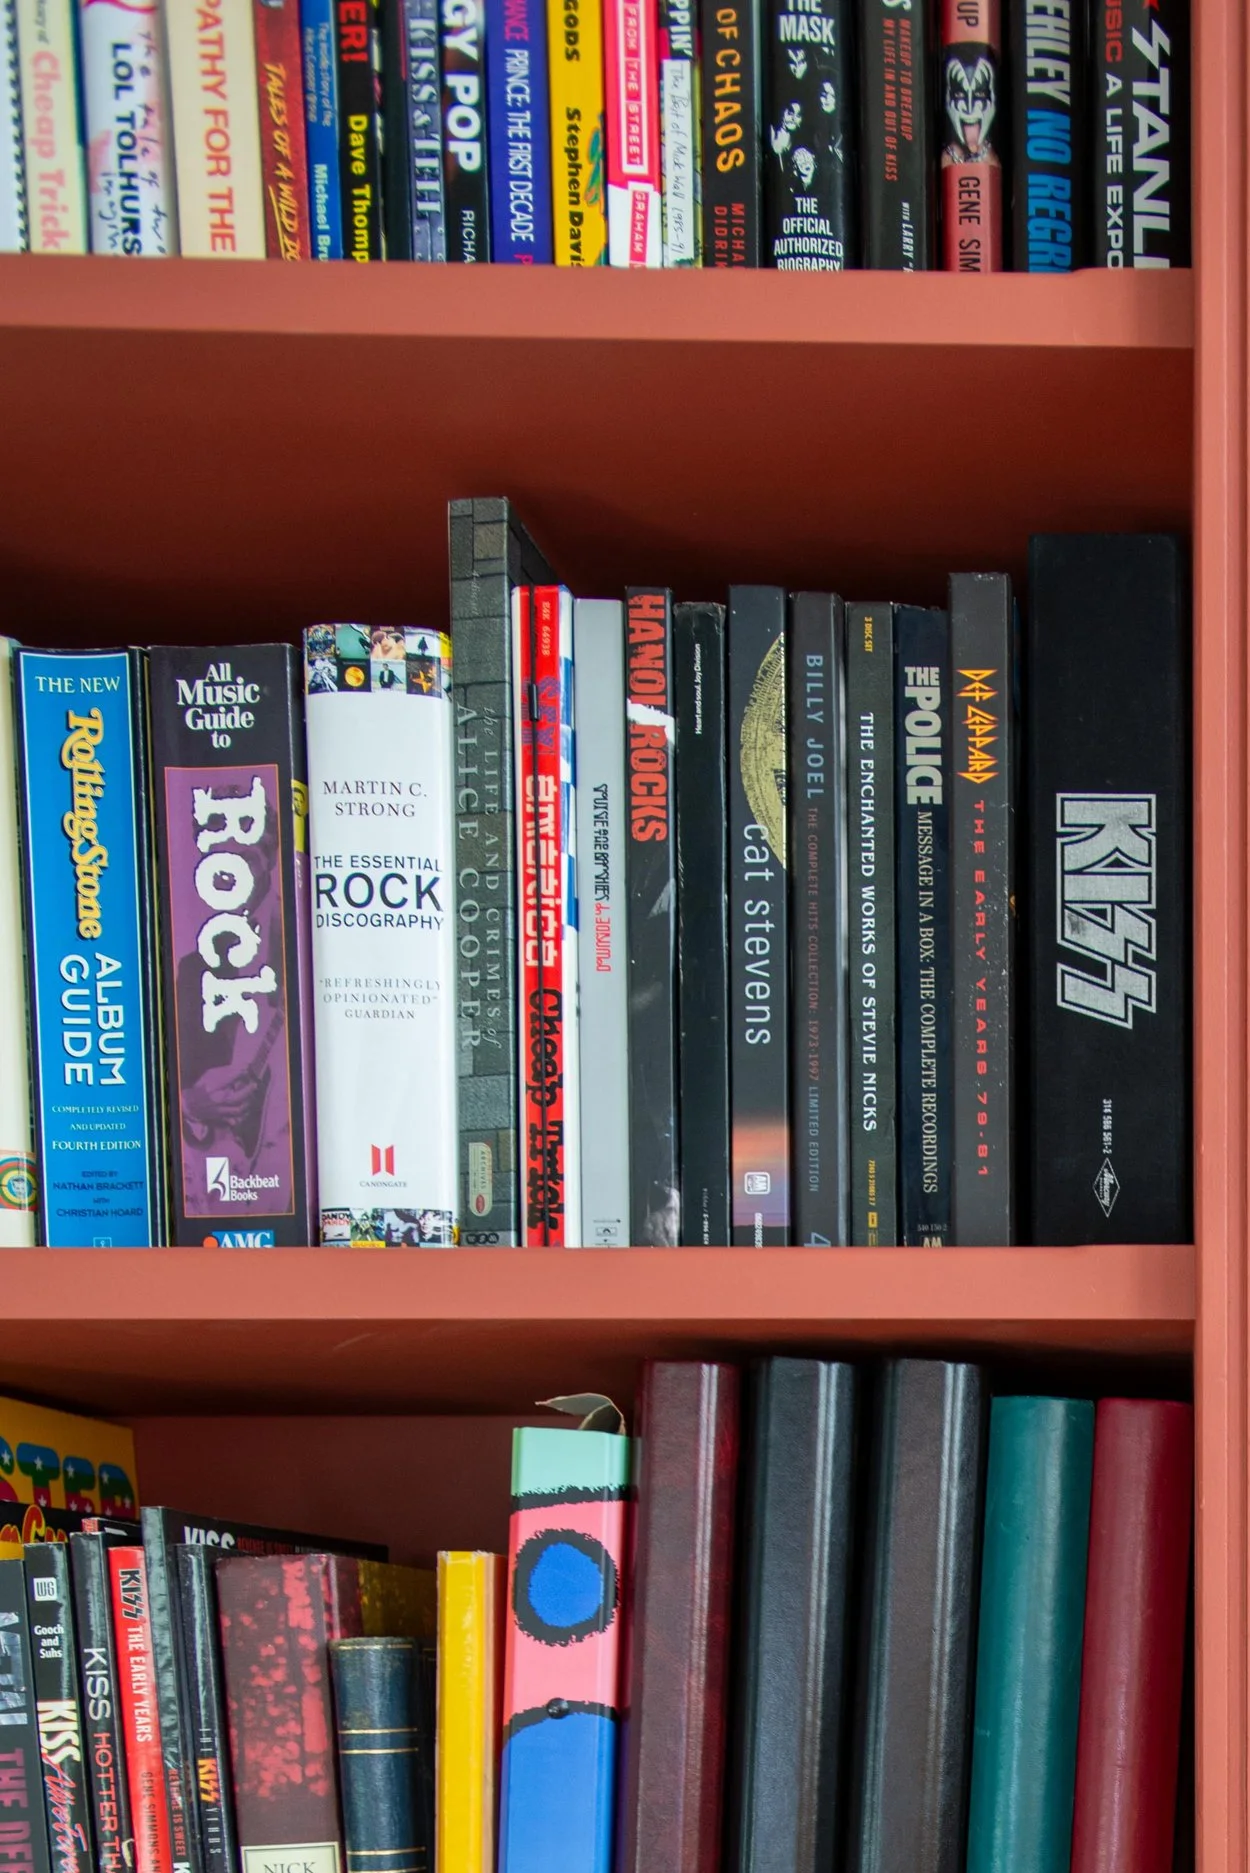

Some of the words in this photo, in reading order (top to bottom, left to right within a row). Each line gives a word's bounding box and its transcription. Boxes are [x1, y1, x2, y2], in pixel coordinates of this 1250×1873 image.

[625, 2, 638, 50] FROM
[716, 8, 738, 40] OF
[779, 14, 835, 44] MASK
[505, 49, 530, 107] PRINCE:
[627, 61, 640, 91] THE
[445, 73, 481, 172] POP
[507, 111, 531, 140] THE
[714, 51, 746, 173] CHAOS
[204, 109, 231, 177] FOR
[628, 103, 641, 165] STREET
[1027, 107, 1072, 165] NO
[508, 141, 532, 178] FIRST
[565, 107, 583, 205] Stephen
[314, 164, 330, 230] Michael
[509, 179, 535, 243] DECADE
[795, 197, 818, 214] THE
[209, 187, 236, 253] THE
[782, 217, 833, 236] OFFICIAL
[774, 237, 844, 257] AUTHORIZED
[35, 676, 76, 693] THE
[80, 676, 120, 693] NEW
[176, 676, 261, 706] Music
[205, 663, 232, 683] All
[806, 654, 824, 724] BILLY
[904, 666, 940, 686] THE
[185, 707, 255, 730] Guide
[211, 731, 232, 749] to
[860, 712, 874, 751] THE
[905, 686, 943, 805] POLICE
[456, 702, 480, 841] ALICE
[806, 737, 825, 800] JOEL
[335, 802, 416, 818] STRONG
[860, 758, 876, 878] ENCHANTED
[314, 856, 344, 869] THE
[351, 855, 444, 873] ESSENTIAL
[743, 822, 774, 882] cat
[315, 872, 444, 912] ROCK
[316, 912, 445, 931] DISCOGRAPHY
[861, 885, 876, 956] WORKS
[459, 867, 482, 1048] COOPER
[744, 899, 775, 1045] stevens
[861, 962, 876, 990] OF
[59, 954, 93, 1086] GUIDE
[95, 952, 127, 1086] ALBUM
[862, 997, 877, 1065] STEVIE
[862, 1072, 878, 1132] NICKS
[52, 1140, 98, 1151] FOURTH
[100, 1140, 142, 1151] EDITION
[230, 1174, 280, 1188] Backbeat
[230, 1189, 258, 1202] Books
[119, 1568, 142, 1620] KISS
[34, 1624, 65, 1637] Gooch
[127, 1625, 145, 1653] THE
[130, 1654, 149, 1697] EARLY
[36, 1700, 83, 1765] KISS
[133, 1700, 153, 1743] YEARS
